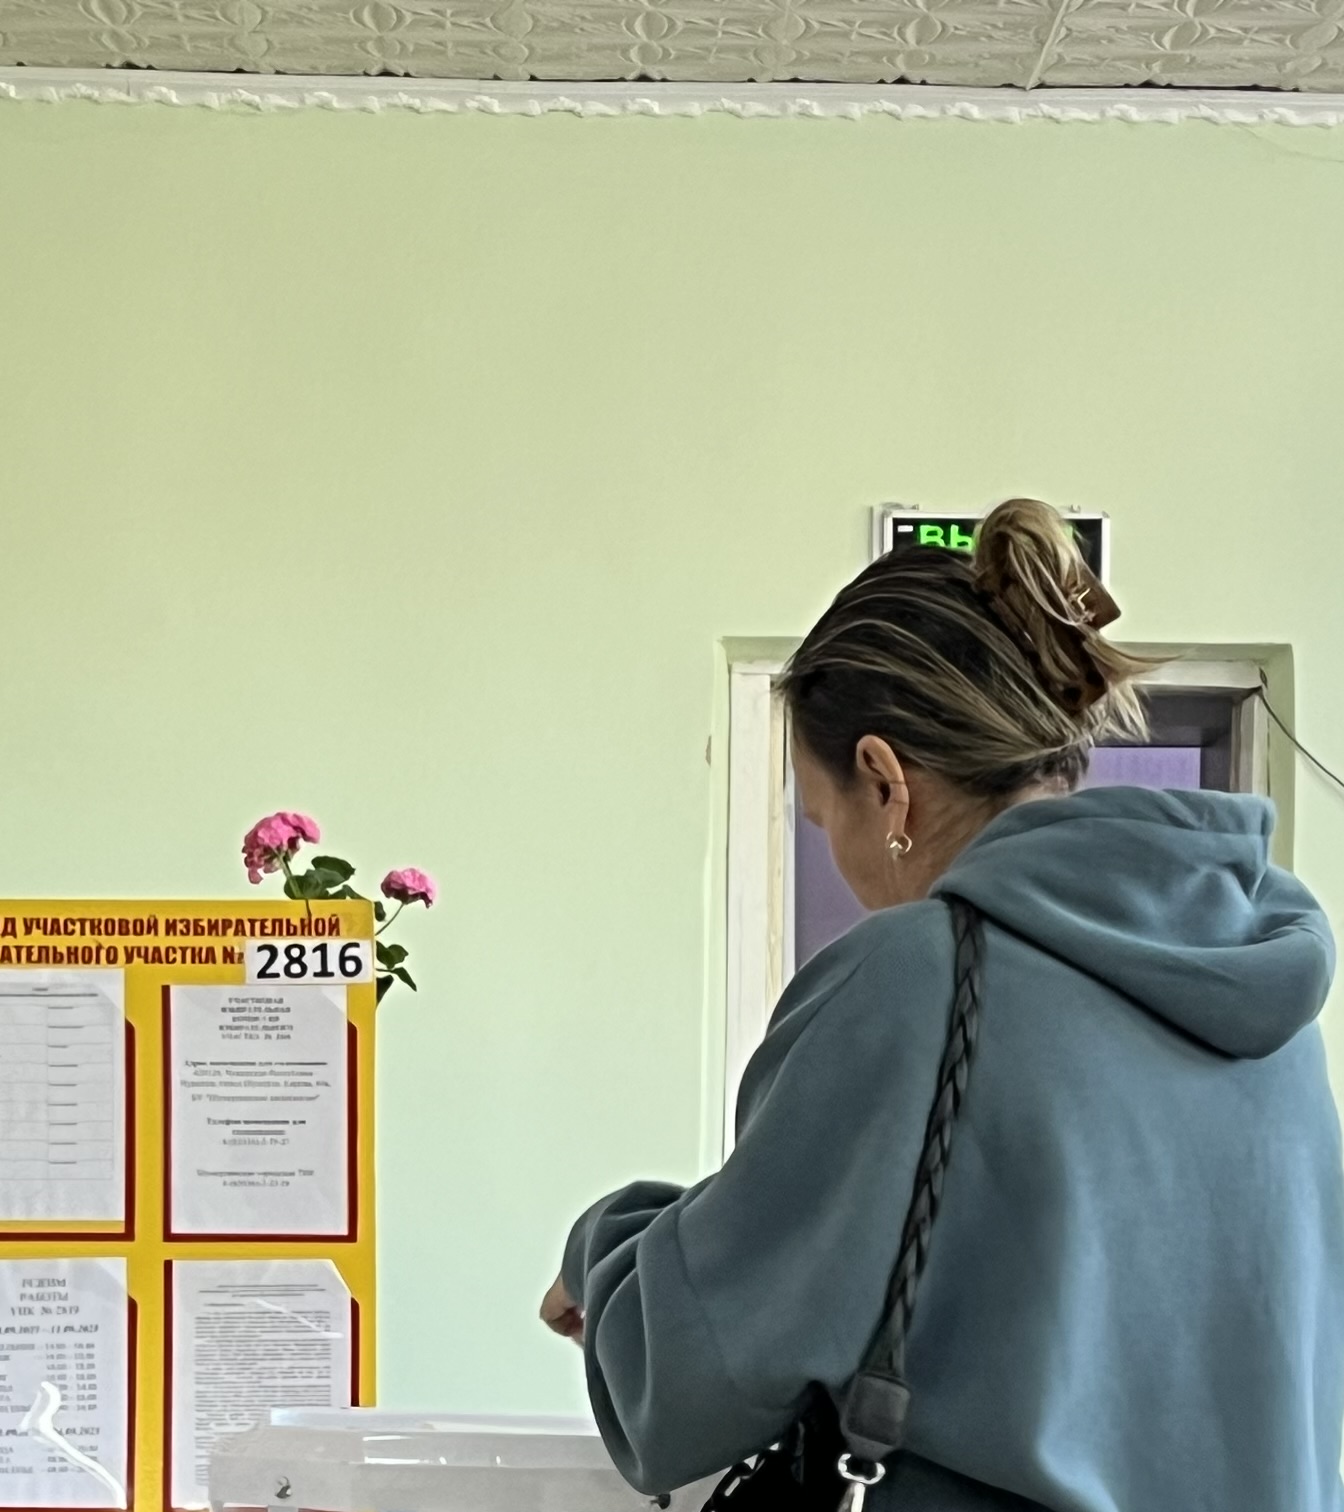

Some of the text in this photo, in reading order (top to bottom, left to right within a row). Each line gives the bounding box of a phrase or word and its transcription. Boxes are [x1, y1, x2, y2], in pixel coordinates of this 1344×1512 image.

[23, 915, 156, 936] УЧАСТКОВОЙ
[164, 914, 341, 937] ИЗБИРАТЕЛЬНОЙ
[124, 945, 217, 965] УЧАСТКА
[256, 942, 364, 980] 2816
